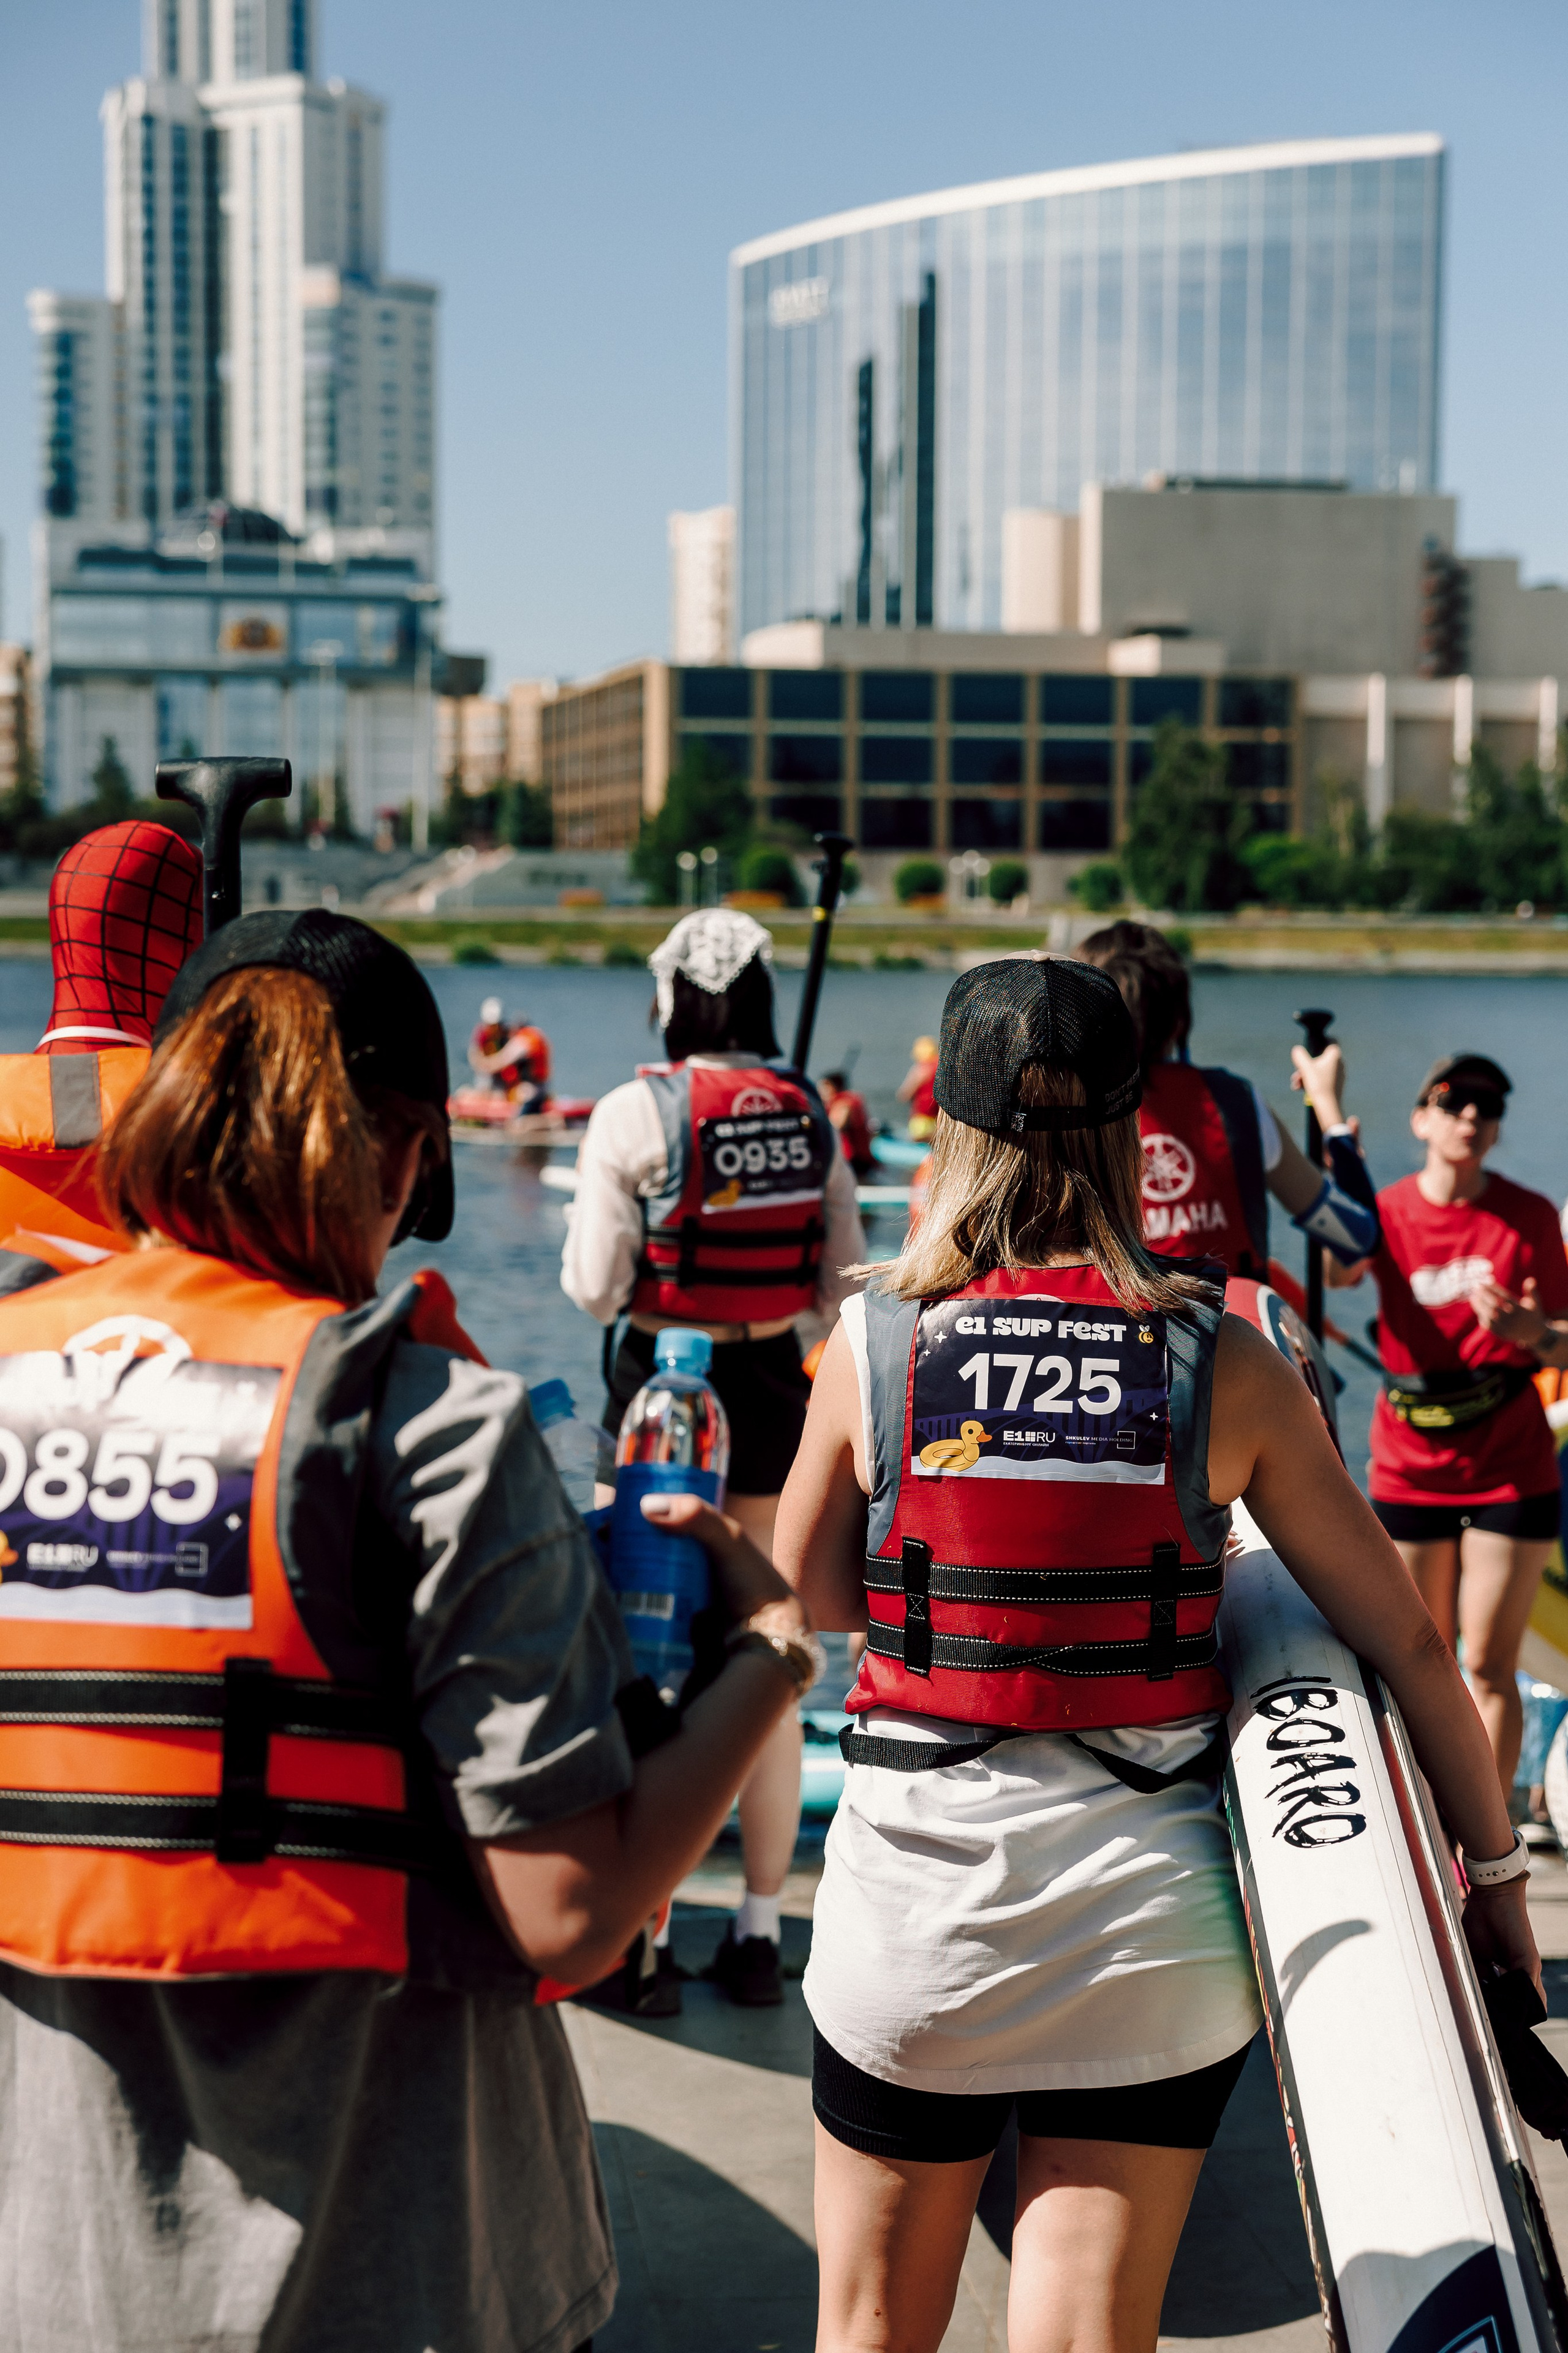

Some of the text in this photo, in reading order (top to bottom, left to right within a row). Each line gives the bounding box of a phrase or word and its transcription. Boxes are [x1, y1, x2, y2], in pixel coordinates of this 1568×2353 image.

[1105, 1090, 1133, 1114] JUST BE
[714, 1136, 811, 1176] 0935
[992, 1317, 1052, 1337] SUP
[957, 1353, 1121, 1415] 1725
